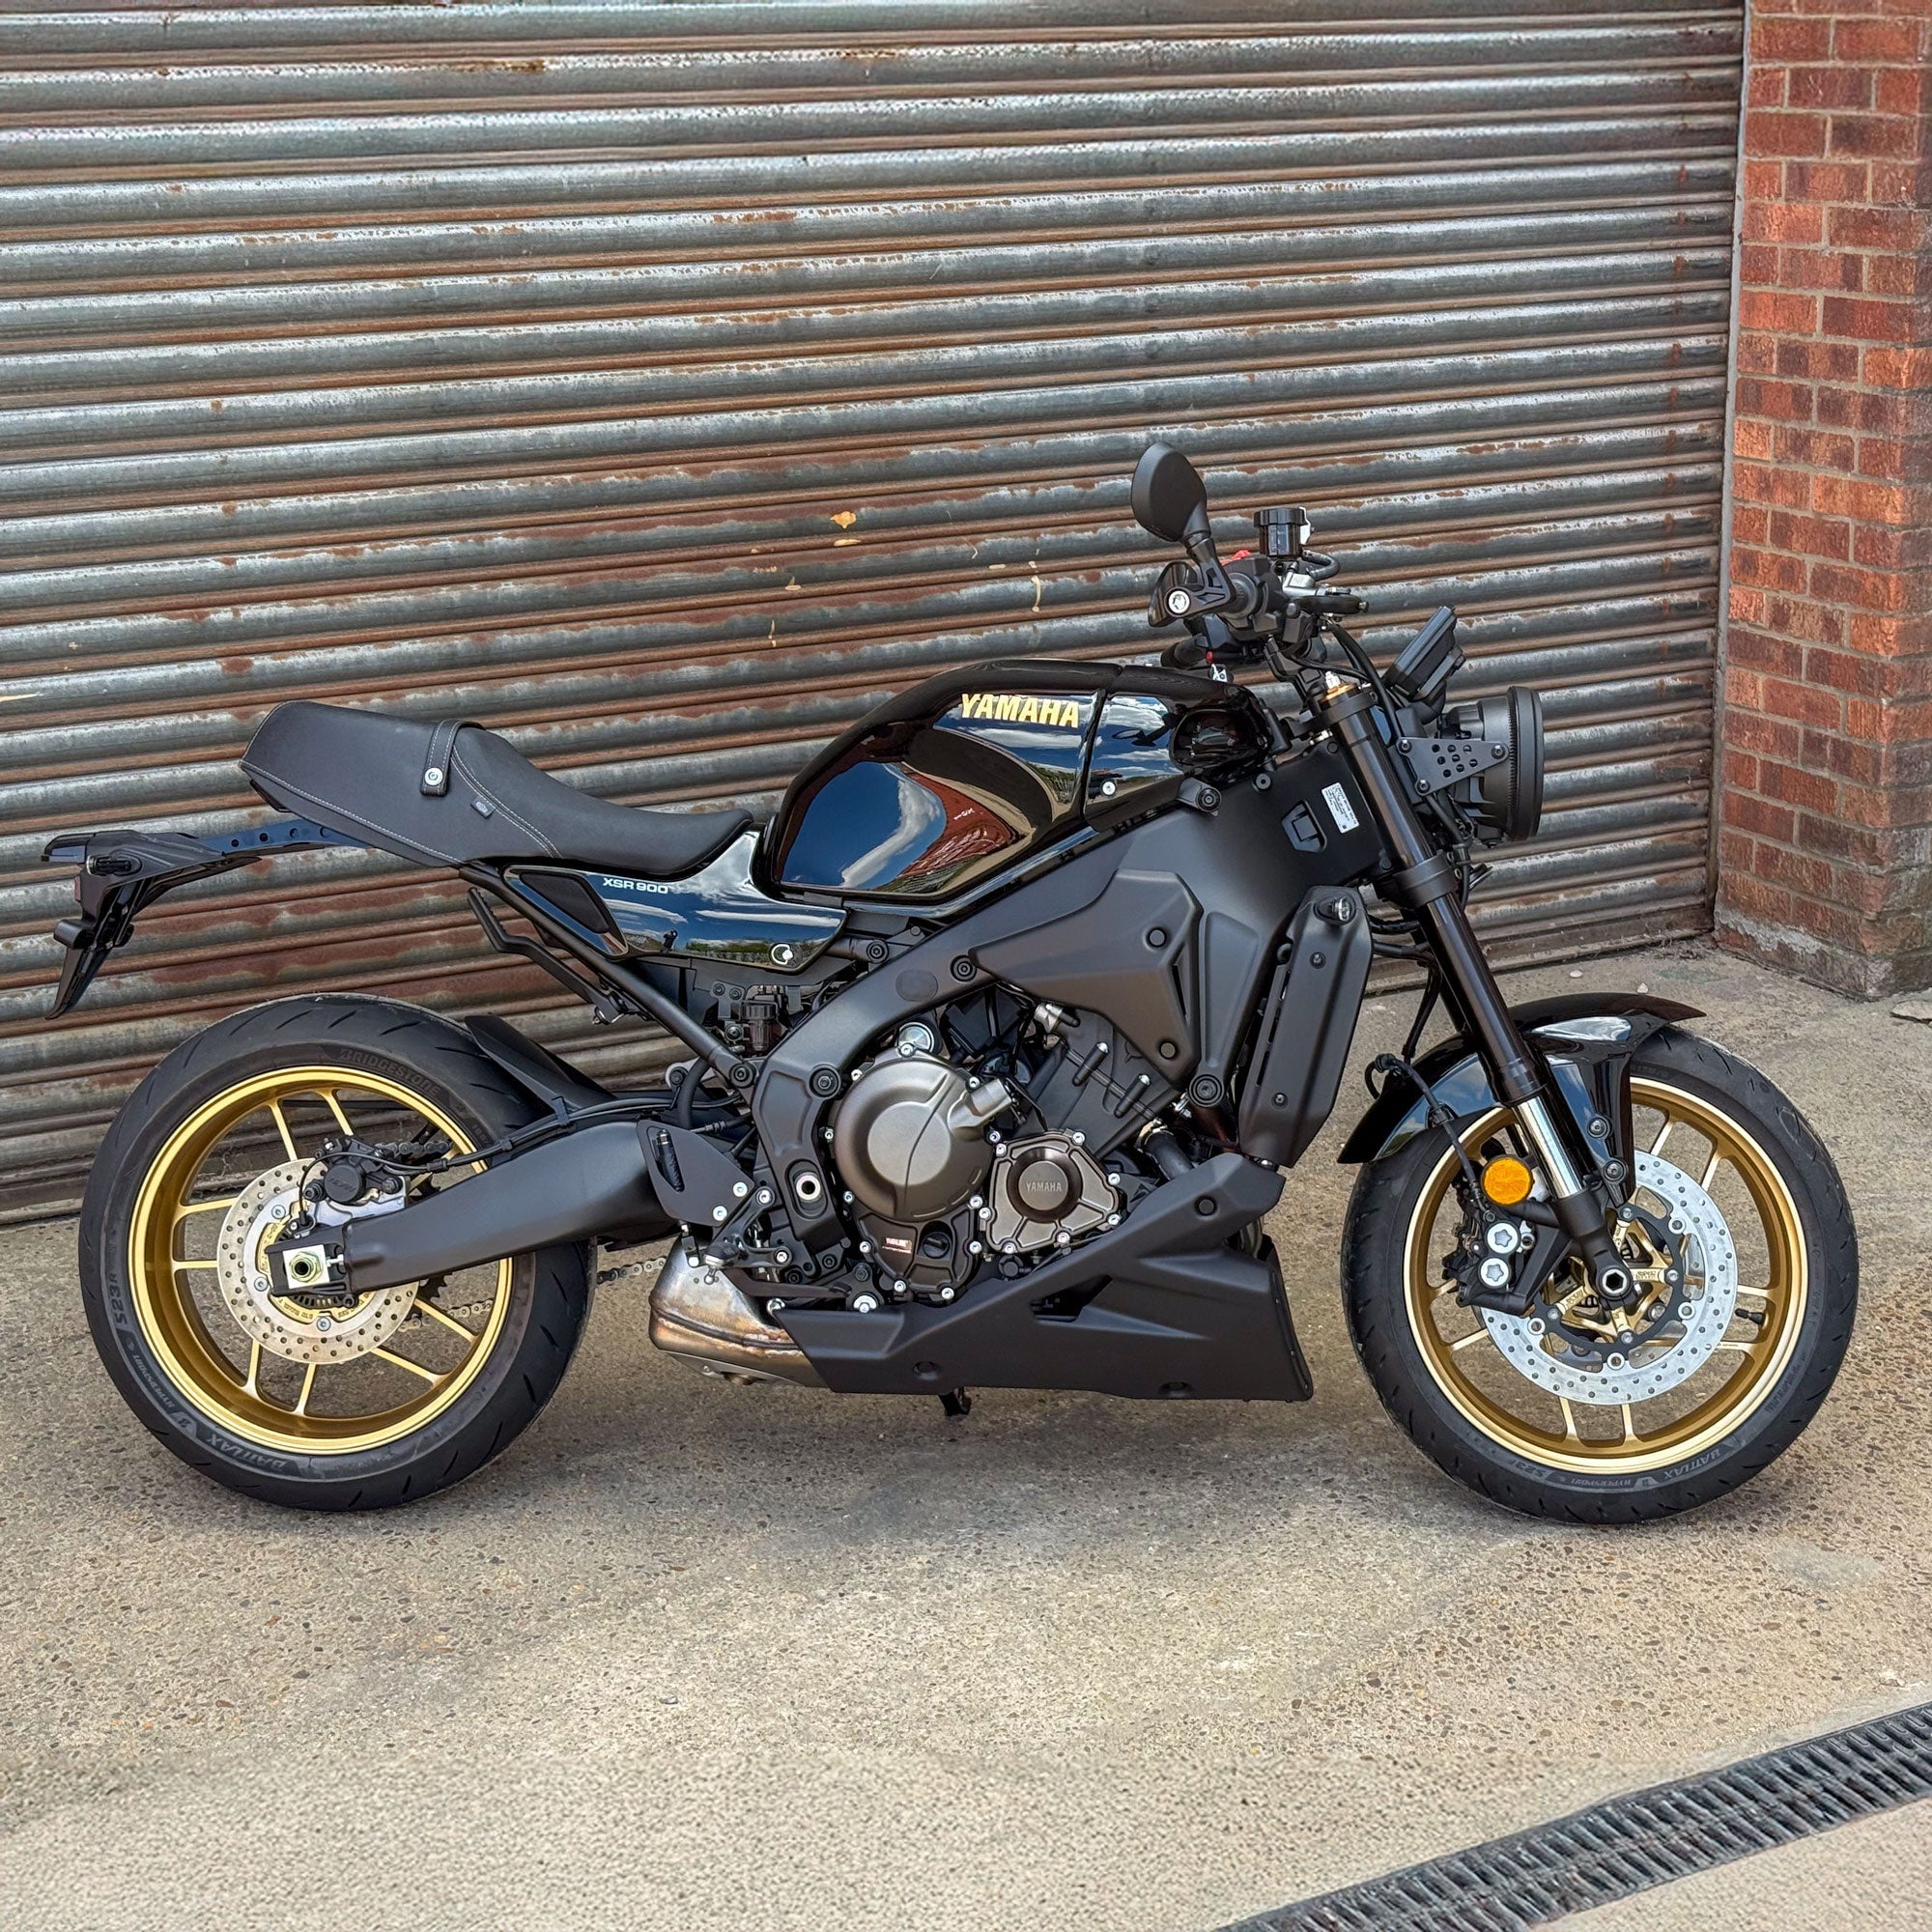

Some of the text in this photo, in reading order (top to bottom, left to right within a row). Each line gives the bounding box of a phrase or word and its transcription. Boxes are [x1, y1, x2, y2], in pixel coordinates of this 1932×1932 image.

[960, 693, 1080, 729] YAMAHA
[602, 877, 668, 895] XSR 900
[338, 1047, 440, 1096] BRIDGESTONE
[1026, 1181, 1063, 1193] YAMAHA
[207, 1433, 287, 1471] BATTLAX
[1663, 1448, 1721, 1480] BATTLAX
[1569, 1477, 1632, 1488] HYPERSPORT
